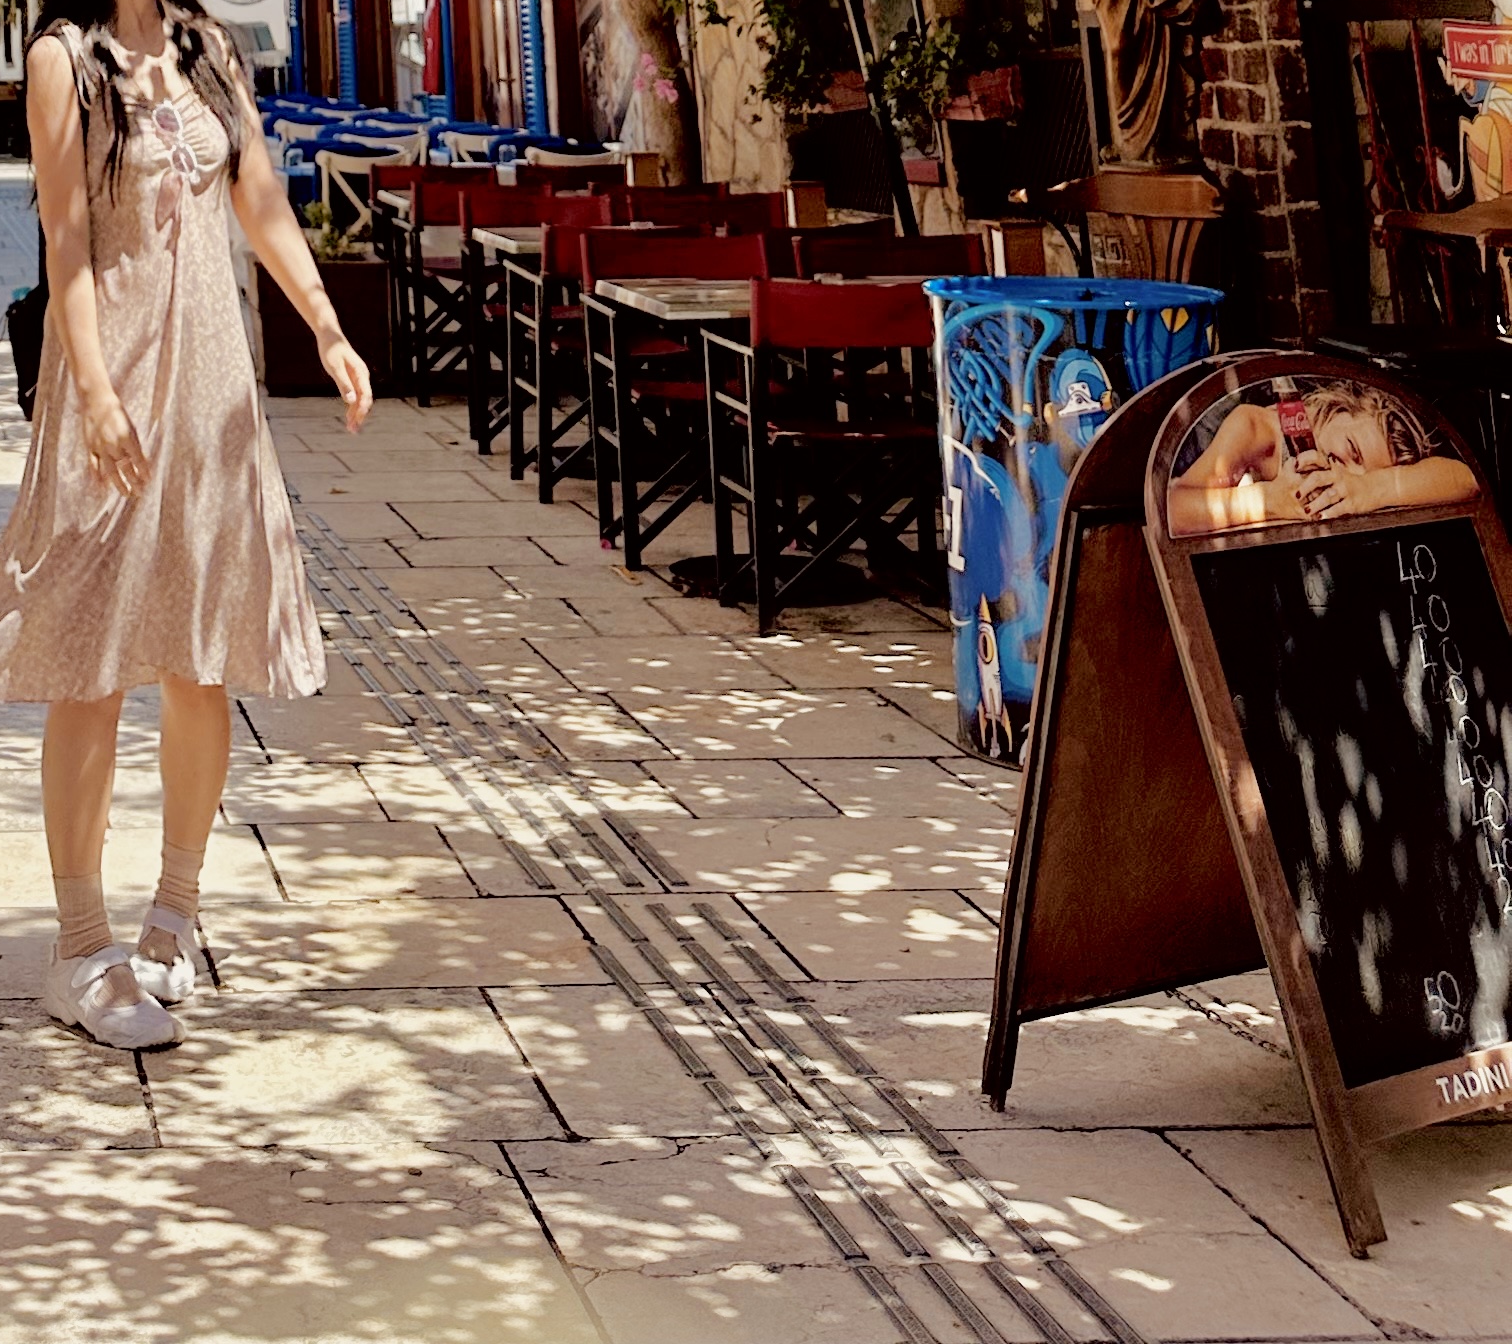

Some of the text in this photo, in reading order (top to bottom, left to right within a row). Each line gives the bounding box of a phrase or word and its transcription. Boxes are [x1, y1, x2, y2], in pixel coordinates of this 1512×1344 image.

[1458, 42, 1478, 64] was
[1478, 40, 1489, 65] in
[1396, 541, 1437, 594] 40
[1435, 1062, 1510, 1105] TADINI
